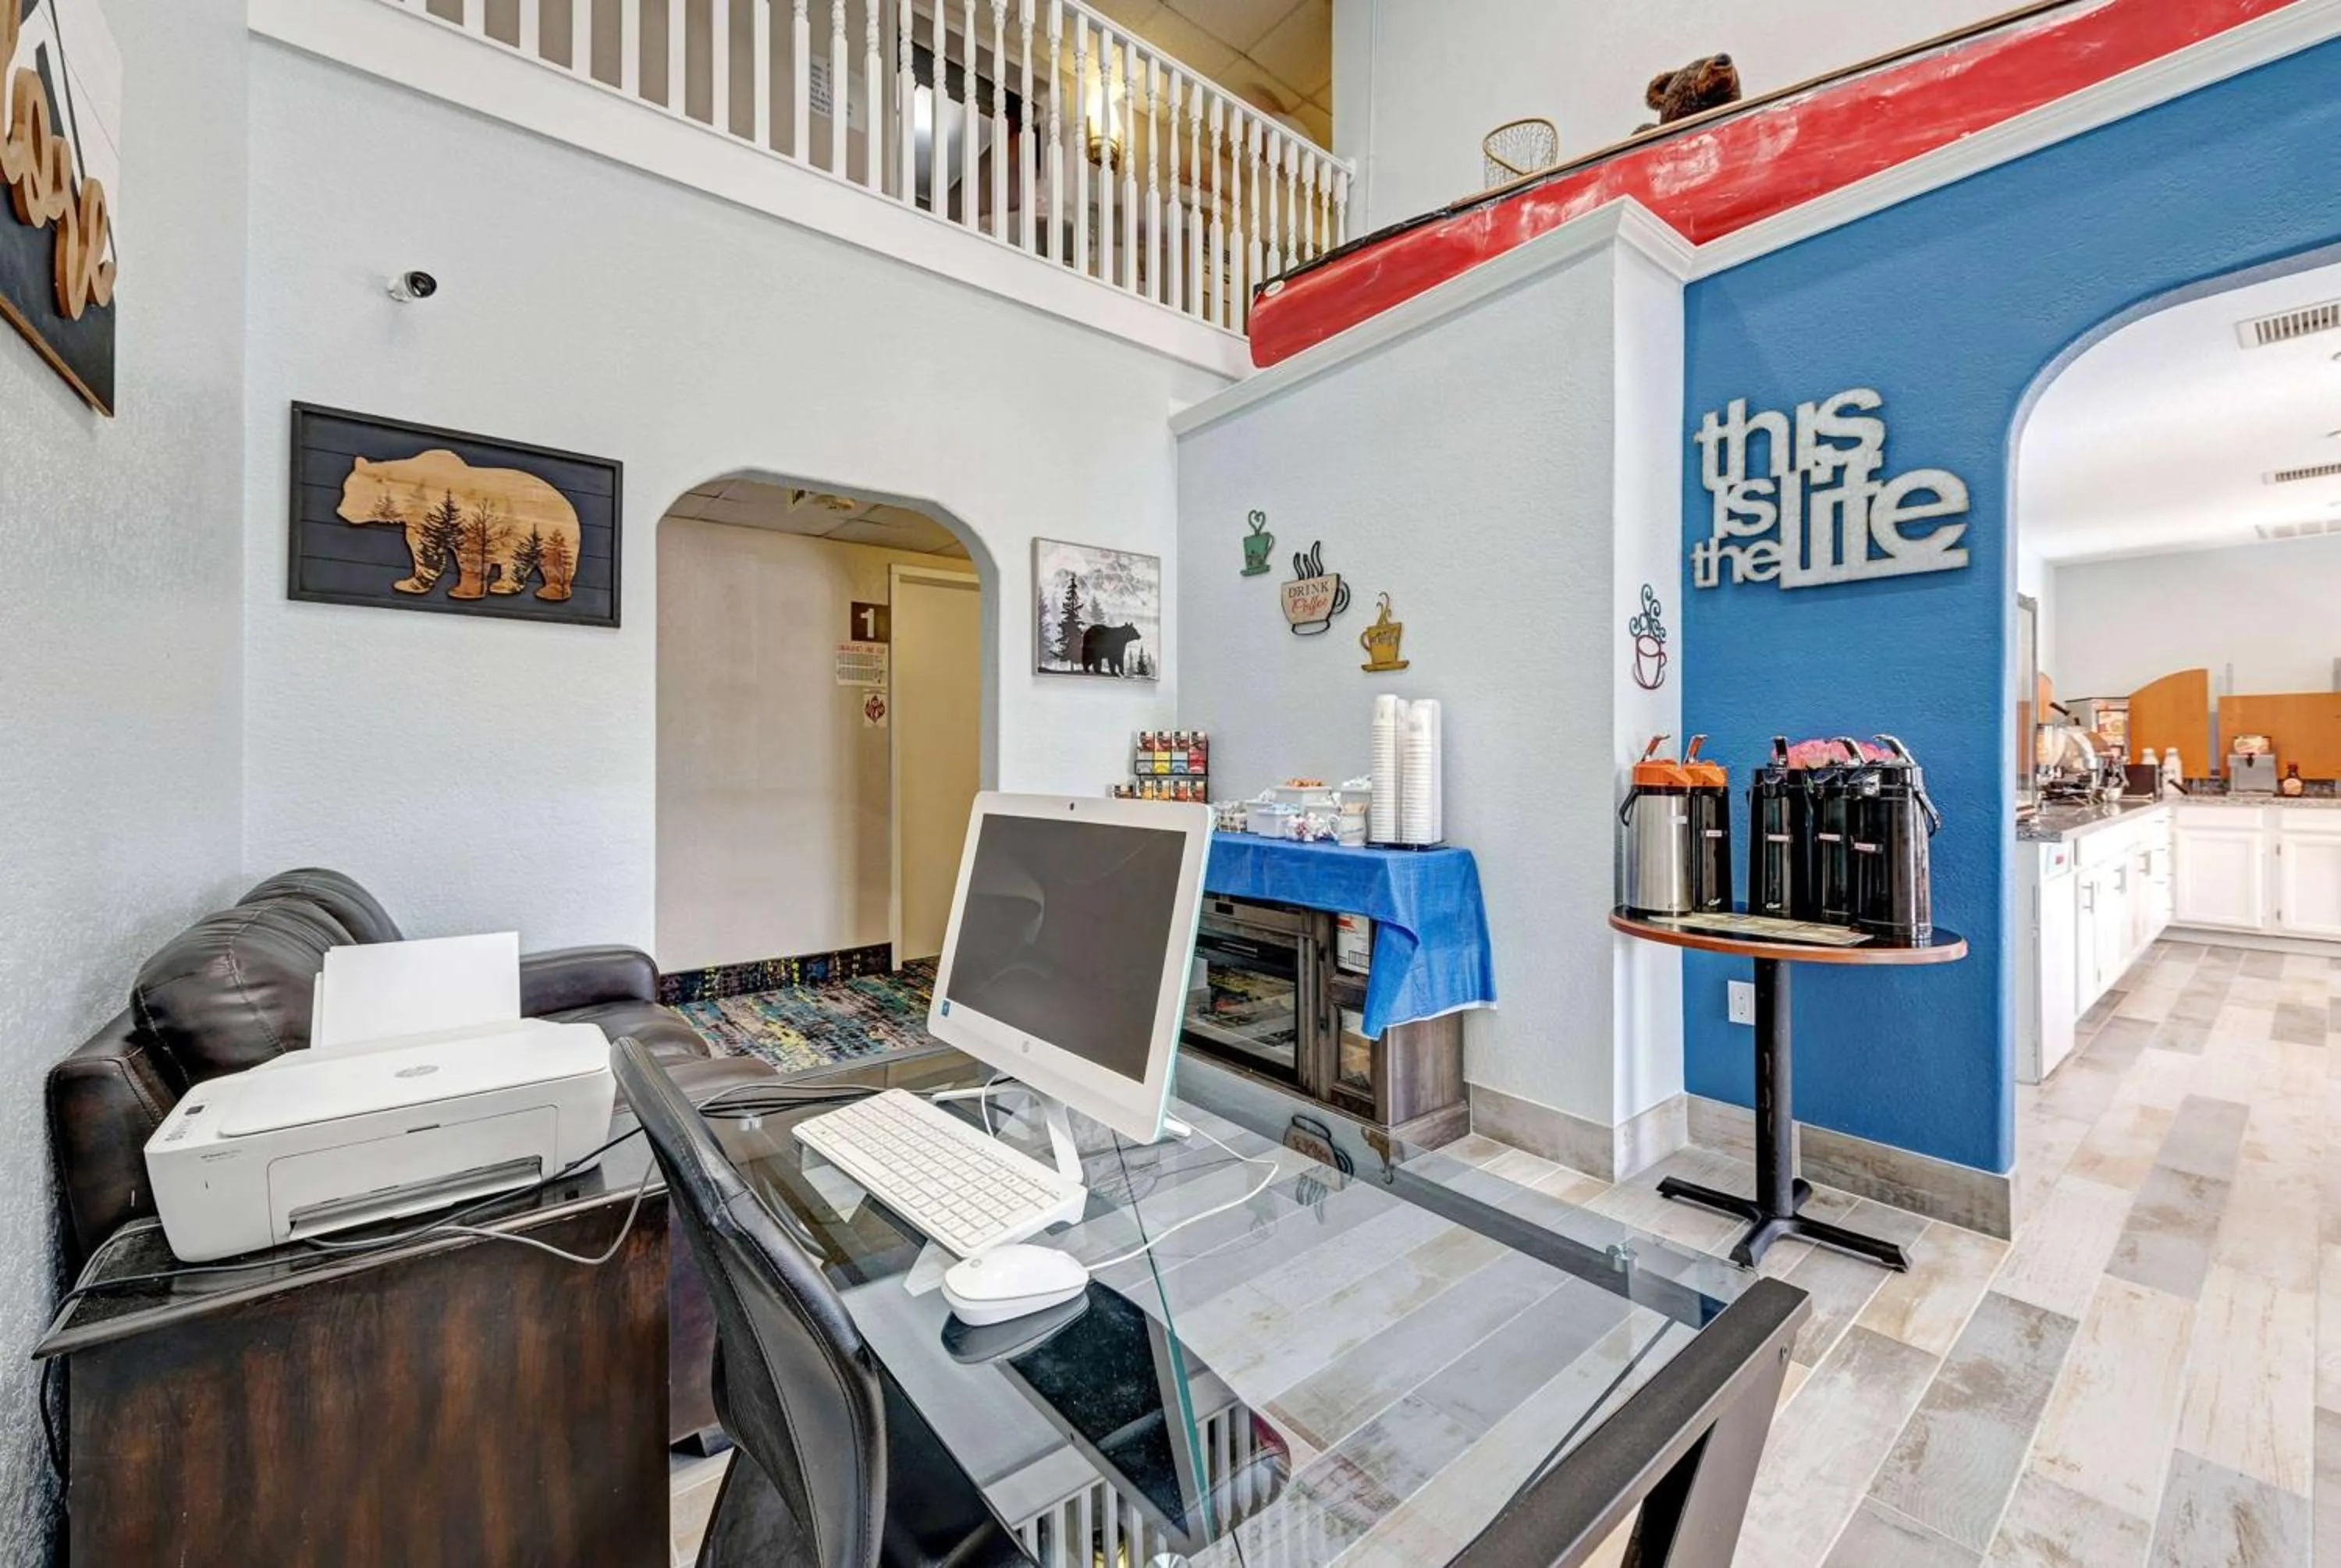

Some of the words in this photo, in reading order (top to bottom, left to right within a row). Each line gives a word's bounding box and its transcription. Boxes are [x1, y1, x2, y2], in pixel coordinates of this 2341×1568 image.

[1693, 388, 1885, 493] this
[1690, 536, 1783, 588] the
[1779, 449, 1970, 590] life
[1714, 478, 1777, 539] is
[1288, 580, 1329, 598] DRINK
[861, 608, 875, 639] 1
